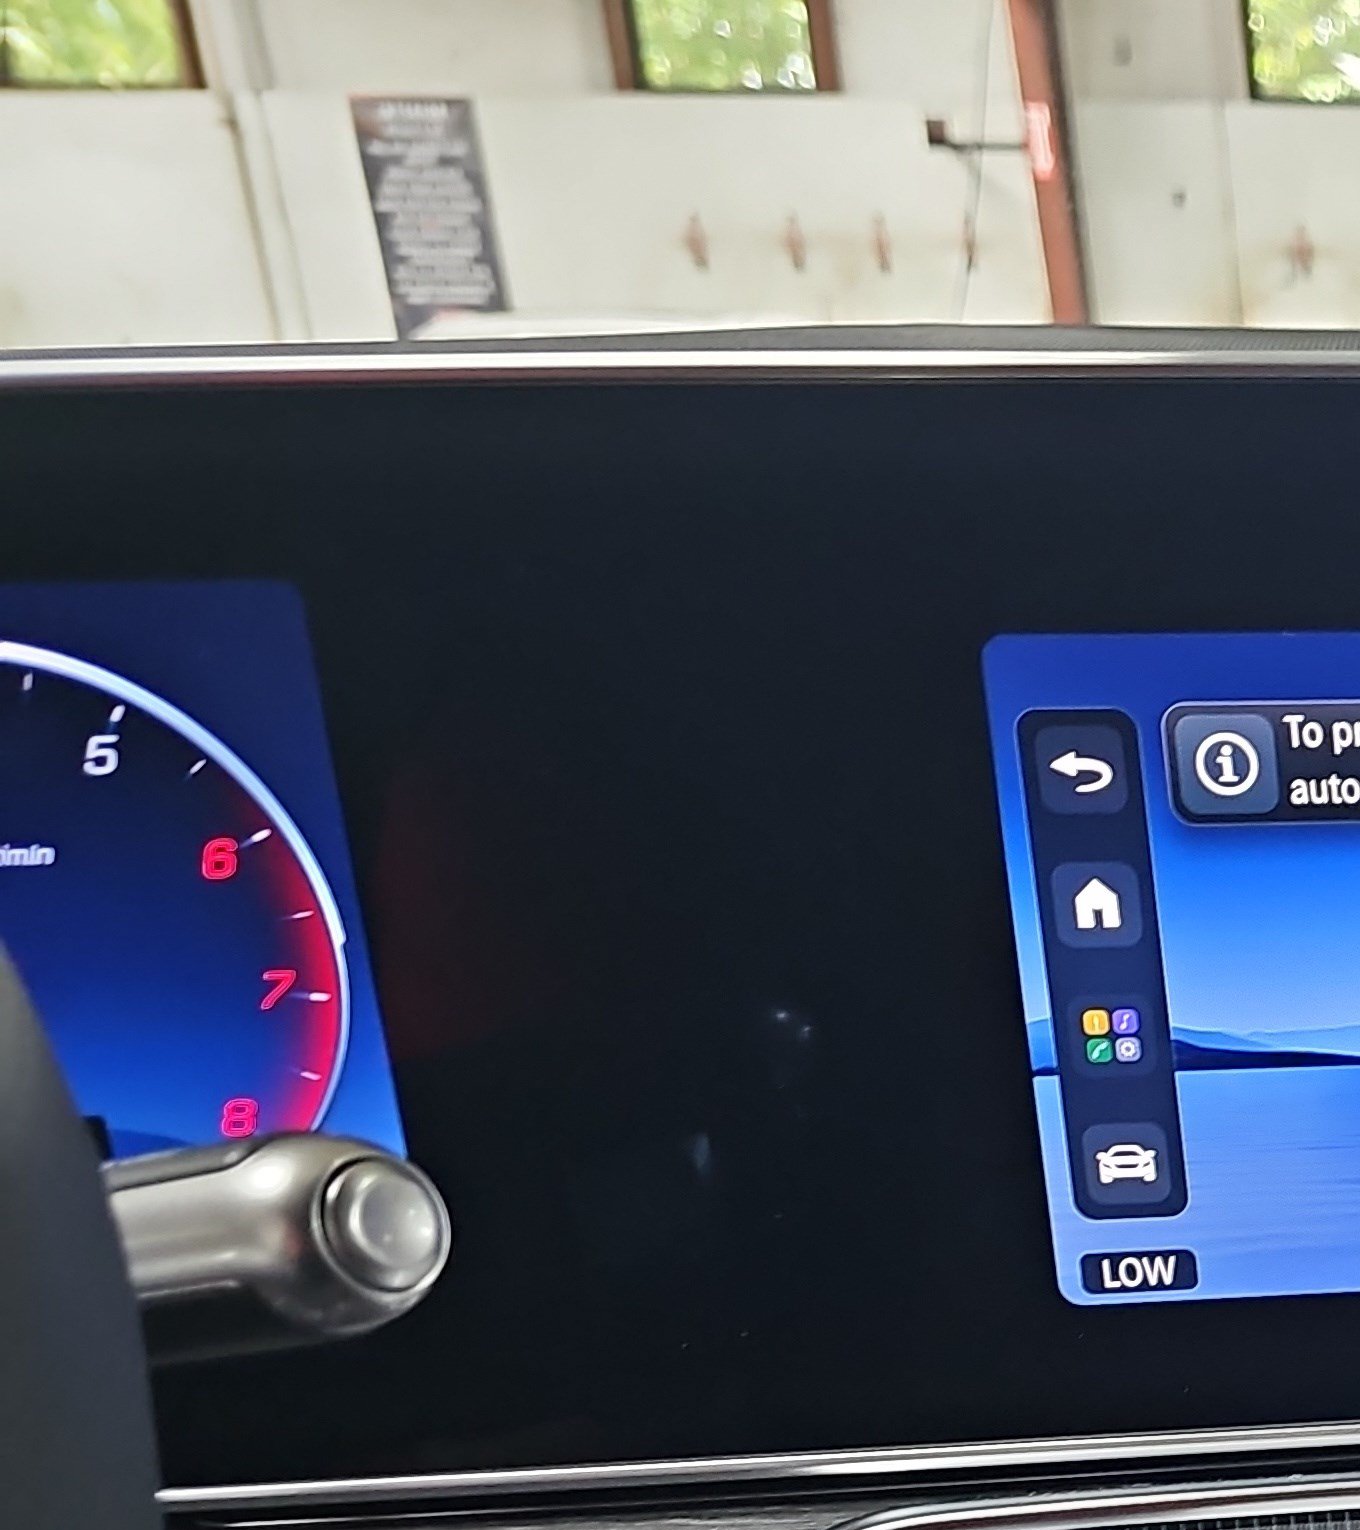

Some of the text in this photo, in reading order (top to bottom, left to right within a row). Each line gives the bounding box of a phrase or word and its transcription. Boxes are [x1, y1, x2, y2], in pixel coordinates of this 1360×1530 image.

[1282, 714, 1325, 749] To
[82, 734, 121, 777] 5
[201, 836, 239, 881] 6
[259, 969, 298, 1011] 7
[220, 1097, 260, 1138] 8
[1101, 1254, 1177, 1289] LOW
